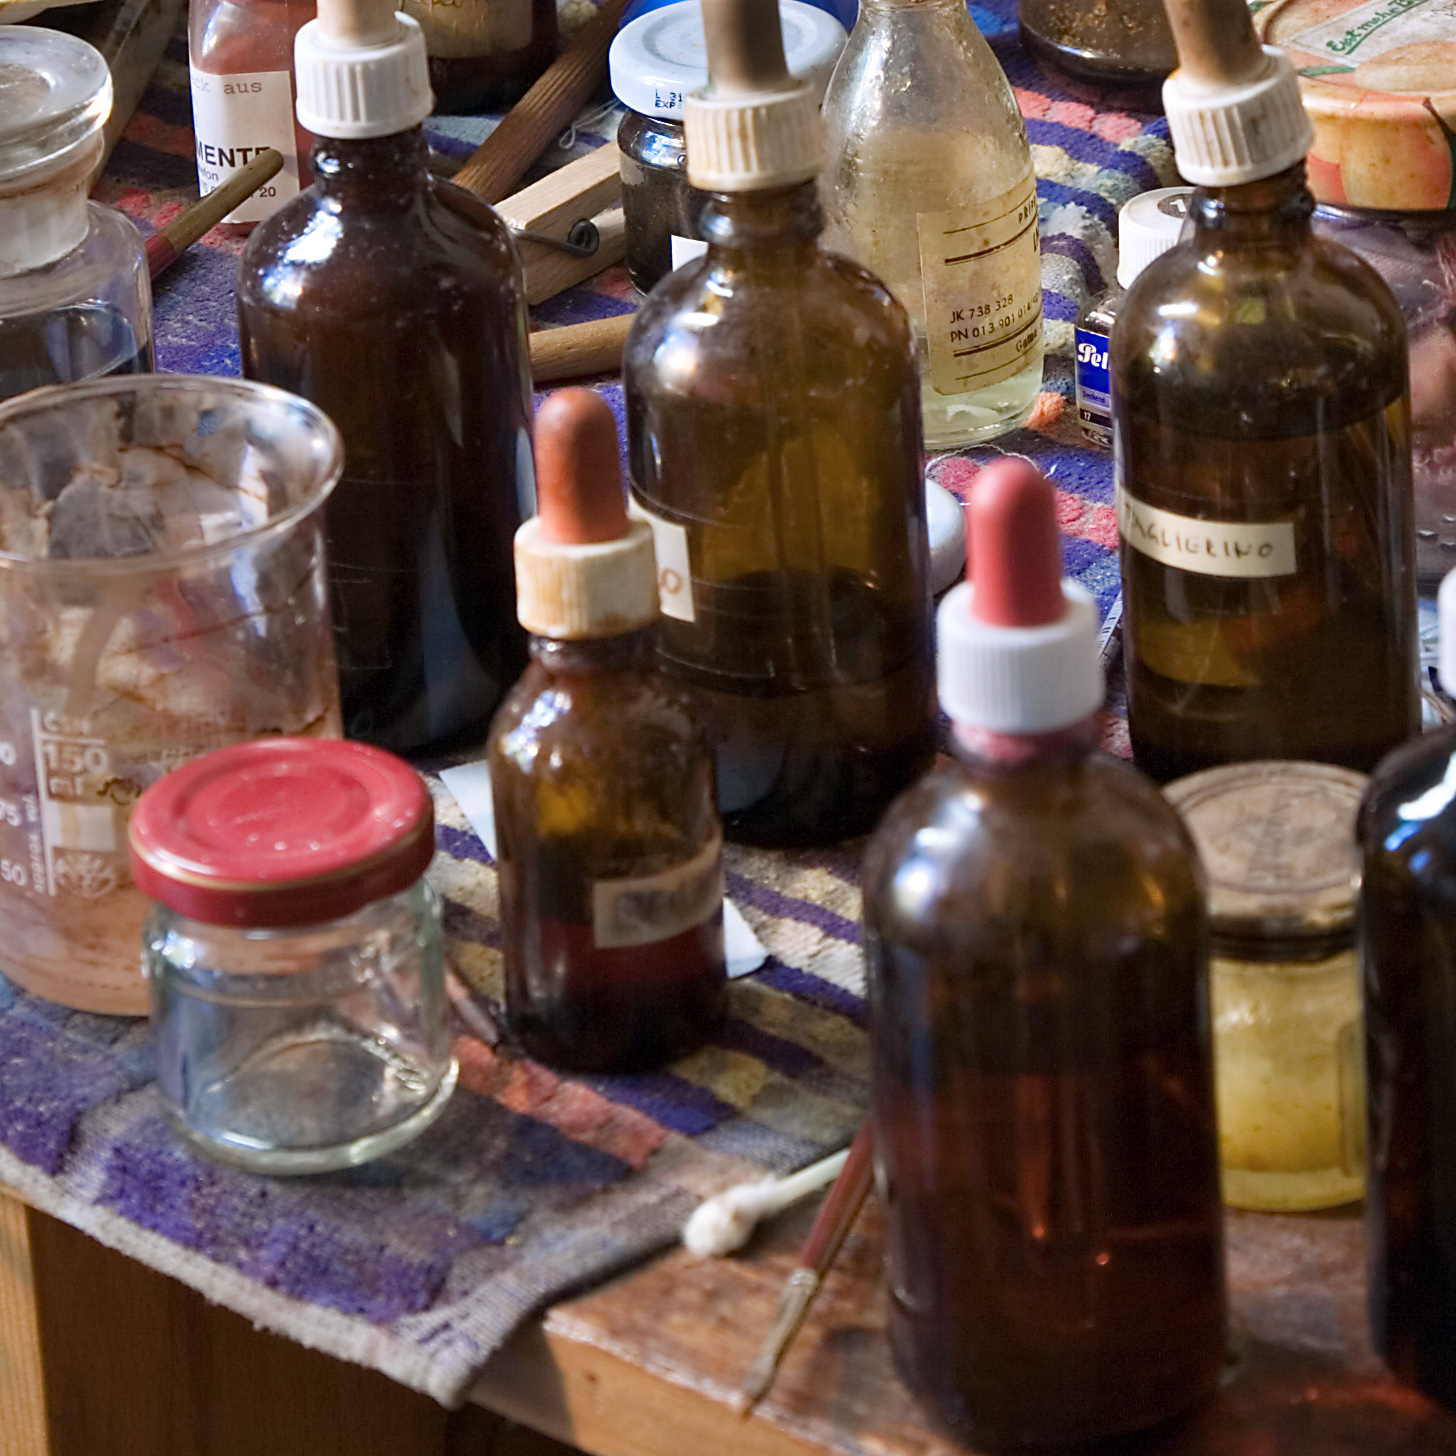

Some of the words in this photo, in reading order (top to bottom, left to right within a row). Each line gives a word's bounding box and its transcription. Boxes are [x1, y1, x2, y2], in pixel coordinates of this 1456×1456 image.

[223, 81, 262, 94] aus
[950, 309, 964, 324] JK
[969, 304, 991, 320] 738
[995, 294, 1014, 312] 328
[950, 329, 968, 343] PN
[972, 322, 995, 338] 013
[998, 313, 1015, 329] 901
[1083, 411, 1091, 421] 17
[44, 743, 108, 774] 150
[0, 859, 28, 887] 50
